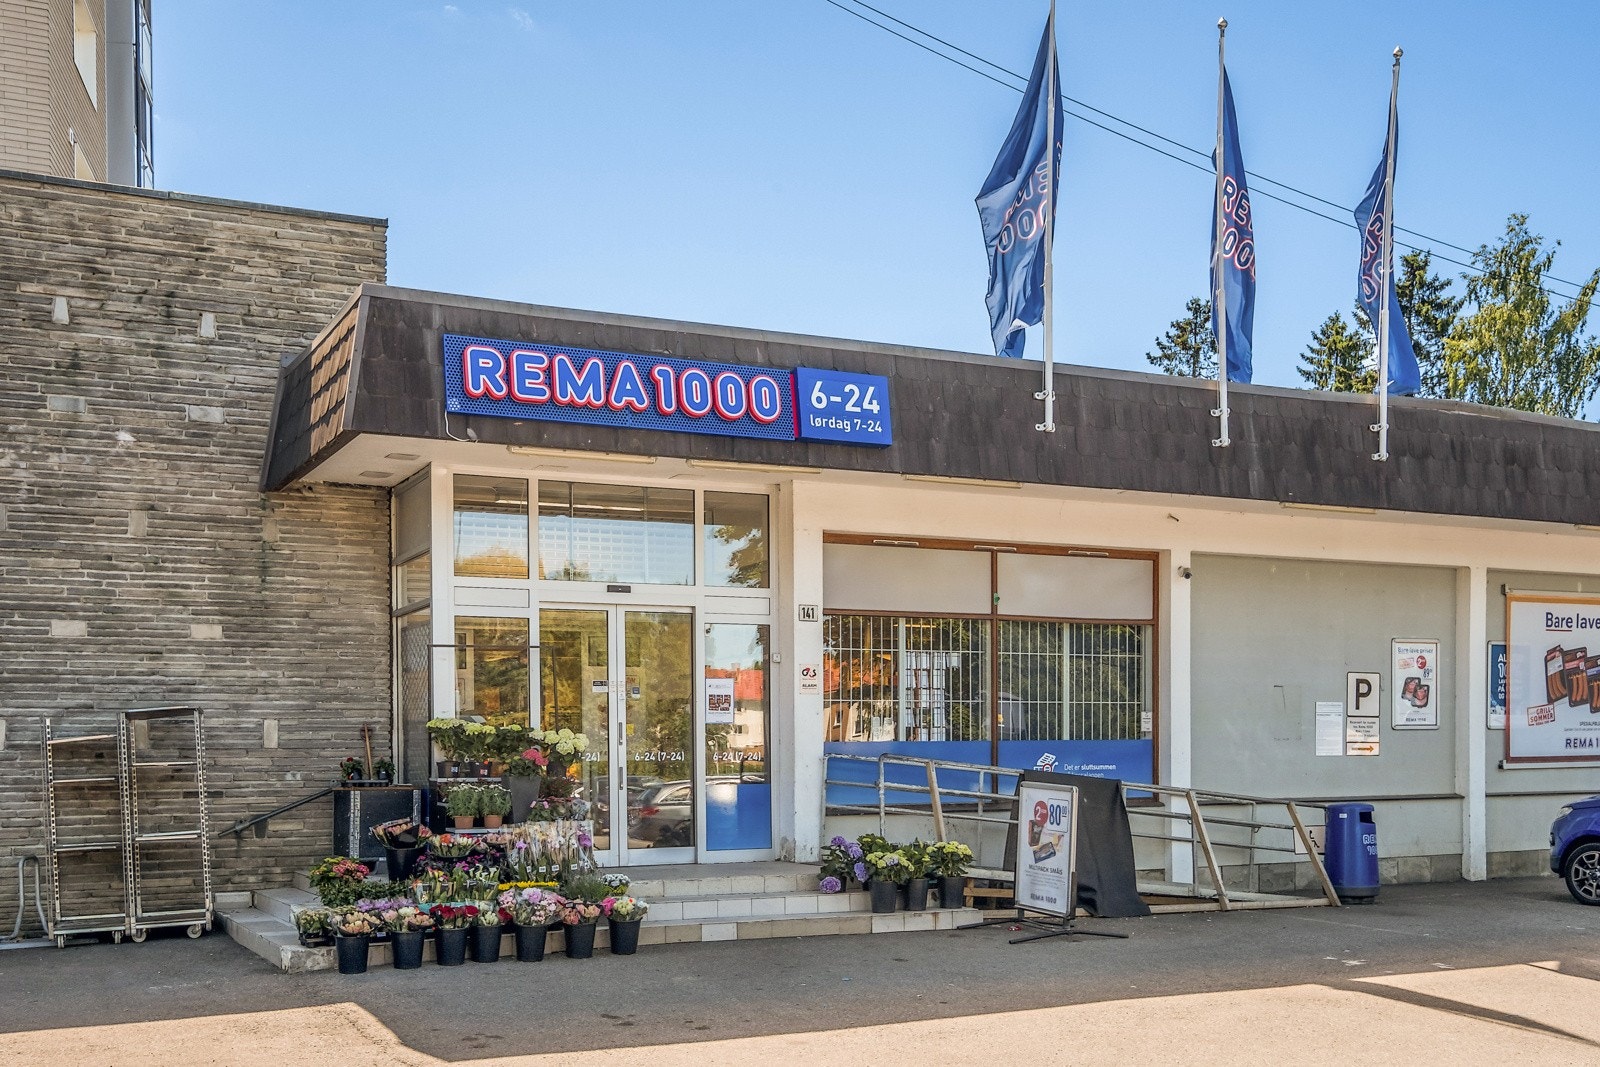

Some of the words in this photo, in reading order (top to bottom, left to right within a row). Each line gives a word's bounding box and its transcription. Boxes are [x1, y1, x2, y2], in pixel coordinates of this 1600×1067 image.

[463, 345, 649, 413] REMA
[651, 364, 782, 425] 1000
[810, 380, 880, 414] 6-24
[810, 413, 851, 433] lørdag
[853, 418, 883, 433] 7-24
[801, 607, 815, 620] 141
[1545, 611, 1573, 629] Bare
[1355, 678, 1372, 710] P
[1565, 737, 1594, 749] REMA
[634, 752, 656, 762] 6-24
[657, 751, 685, 762] (7-24)
[712, 752, 733, 762] 6-24
[735, 751, 762, 762] (7-24)
[1064, 763, 1074, 771] Det
